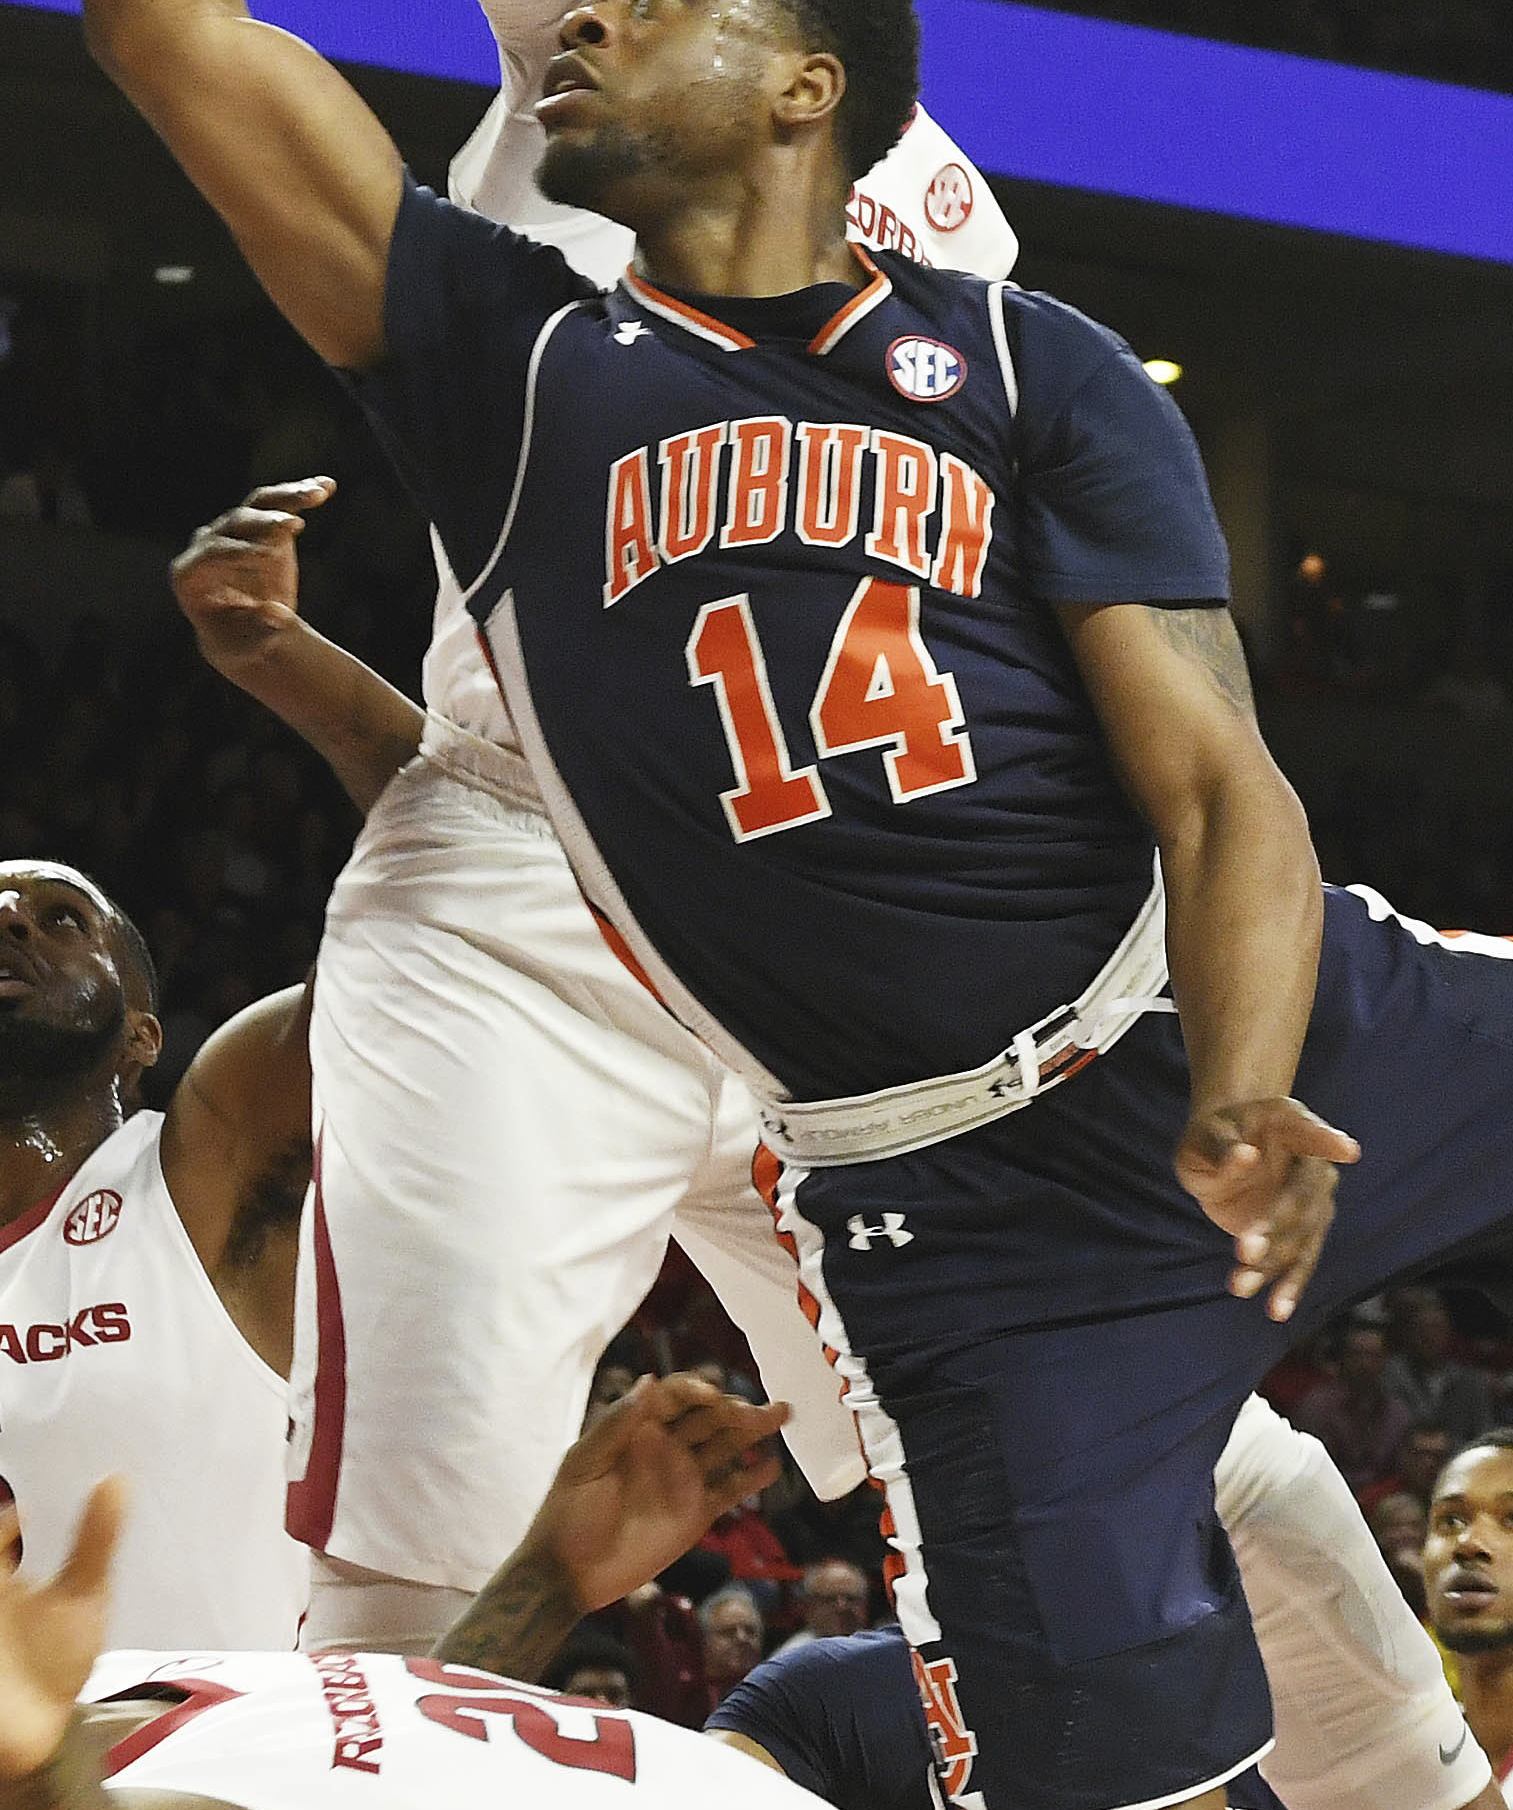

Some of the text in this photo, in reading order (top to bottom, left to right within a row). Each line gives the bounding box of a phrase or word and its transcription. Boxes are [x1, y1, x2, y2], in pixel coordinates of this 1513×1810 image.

[890, 338, 960, 398] SEC
[603, 416, 995, 609] AUBURN
[686, 575, 977, 844] 14
[66, 1190, 121, 1243] SEC
[401, 1654, 636, 1785] 2
